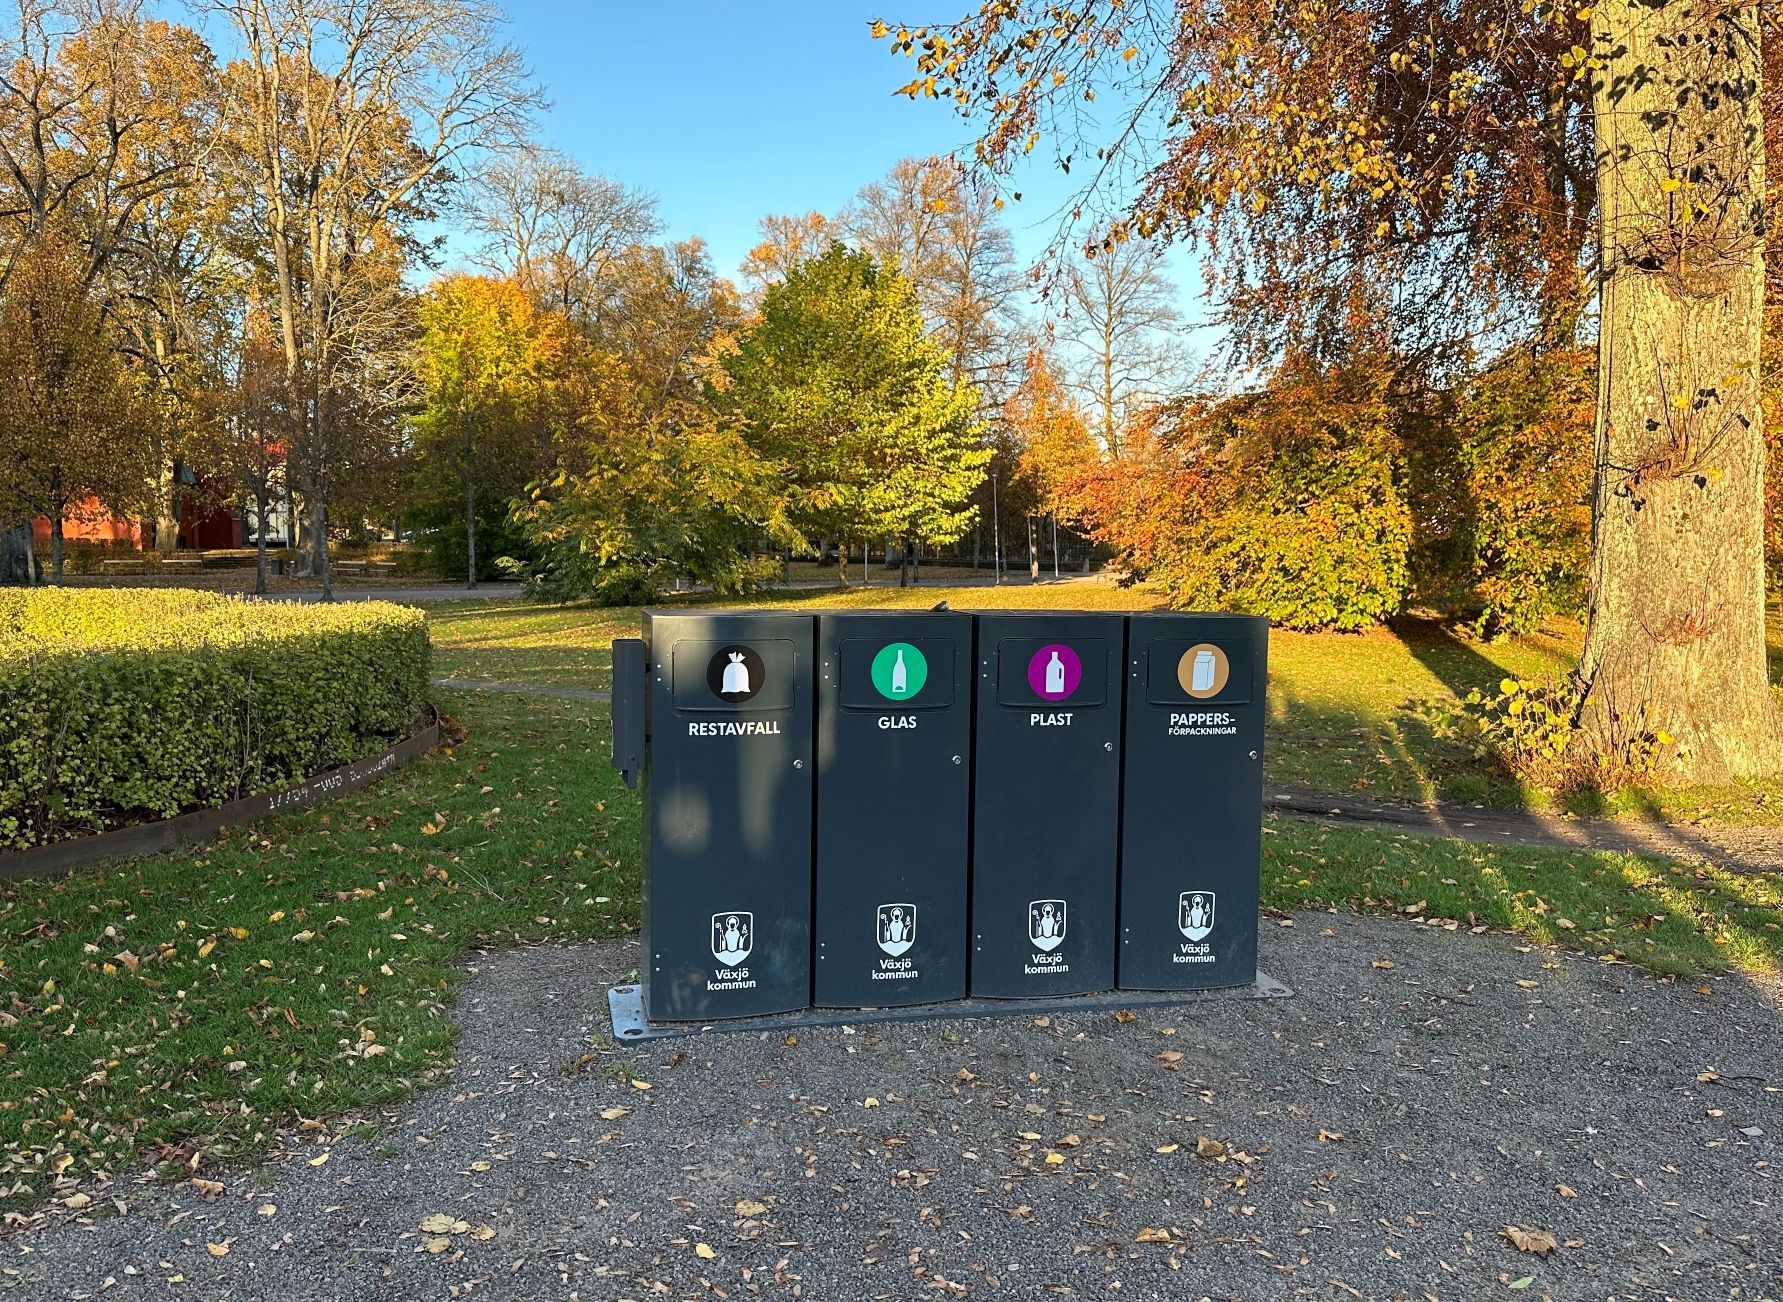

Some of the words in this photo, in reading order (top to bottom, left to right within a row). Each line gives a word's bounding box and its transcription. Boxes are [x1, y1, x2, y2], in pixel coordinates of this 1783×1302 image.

[877, 715, 917, 730] GLAS
[1030, 713, 1074, 726] PLAST
[1170, 712, 1236, 726] PAPPERS-
[688, 721, 781, 736] RESTAVFALL
[1168, 726, 1237, 736] FÖRPACKNINGAR
[1180, 943, 1210, 956] Växjö
[879, 958, 912, 971] Växjö
[1031, 952, 1063, 966] Växjö
[1172, 953, 1216, 963] kommun
[714, 967, 750, 981] Växjö
[871, 969, 919, 980] kommun
[1024, 964, 1069, 975] kommun
[706, 980, 757, 991] kommun
